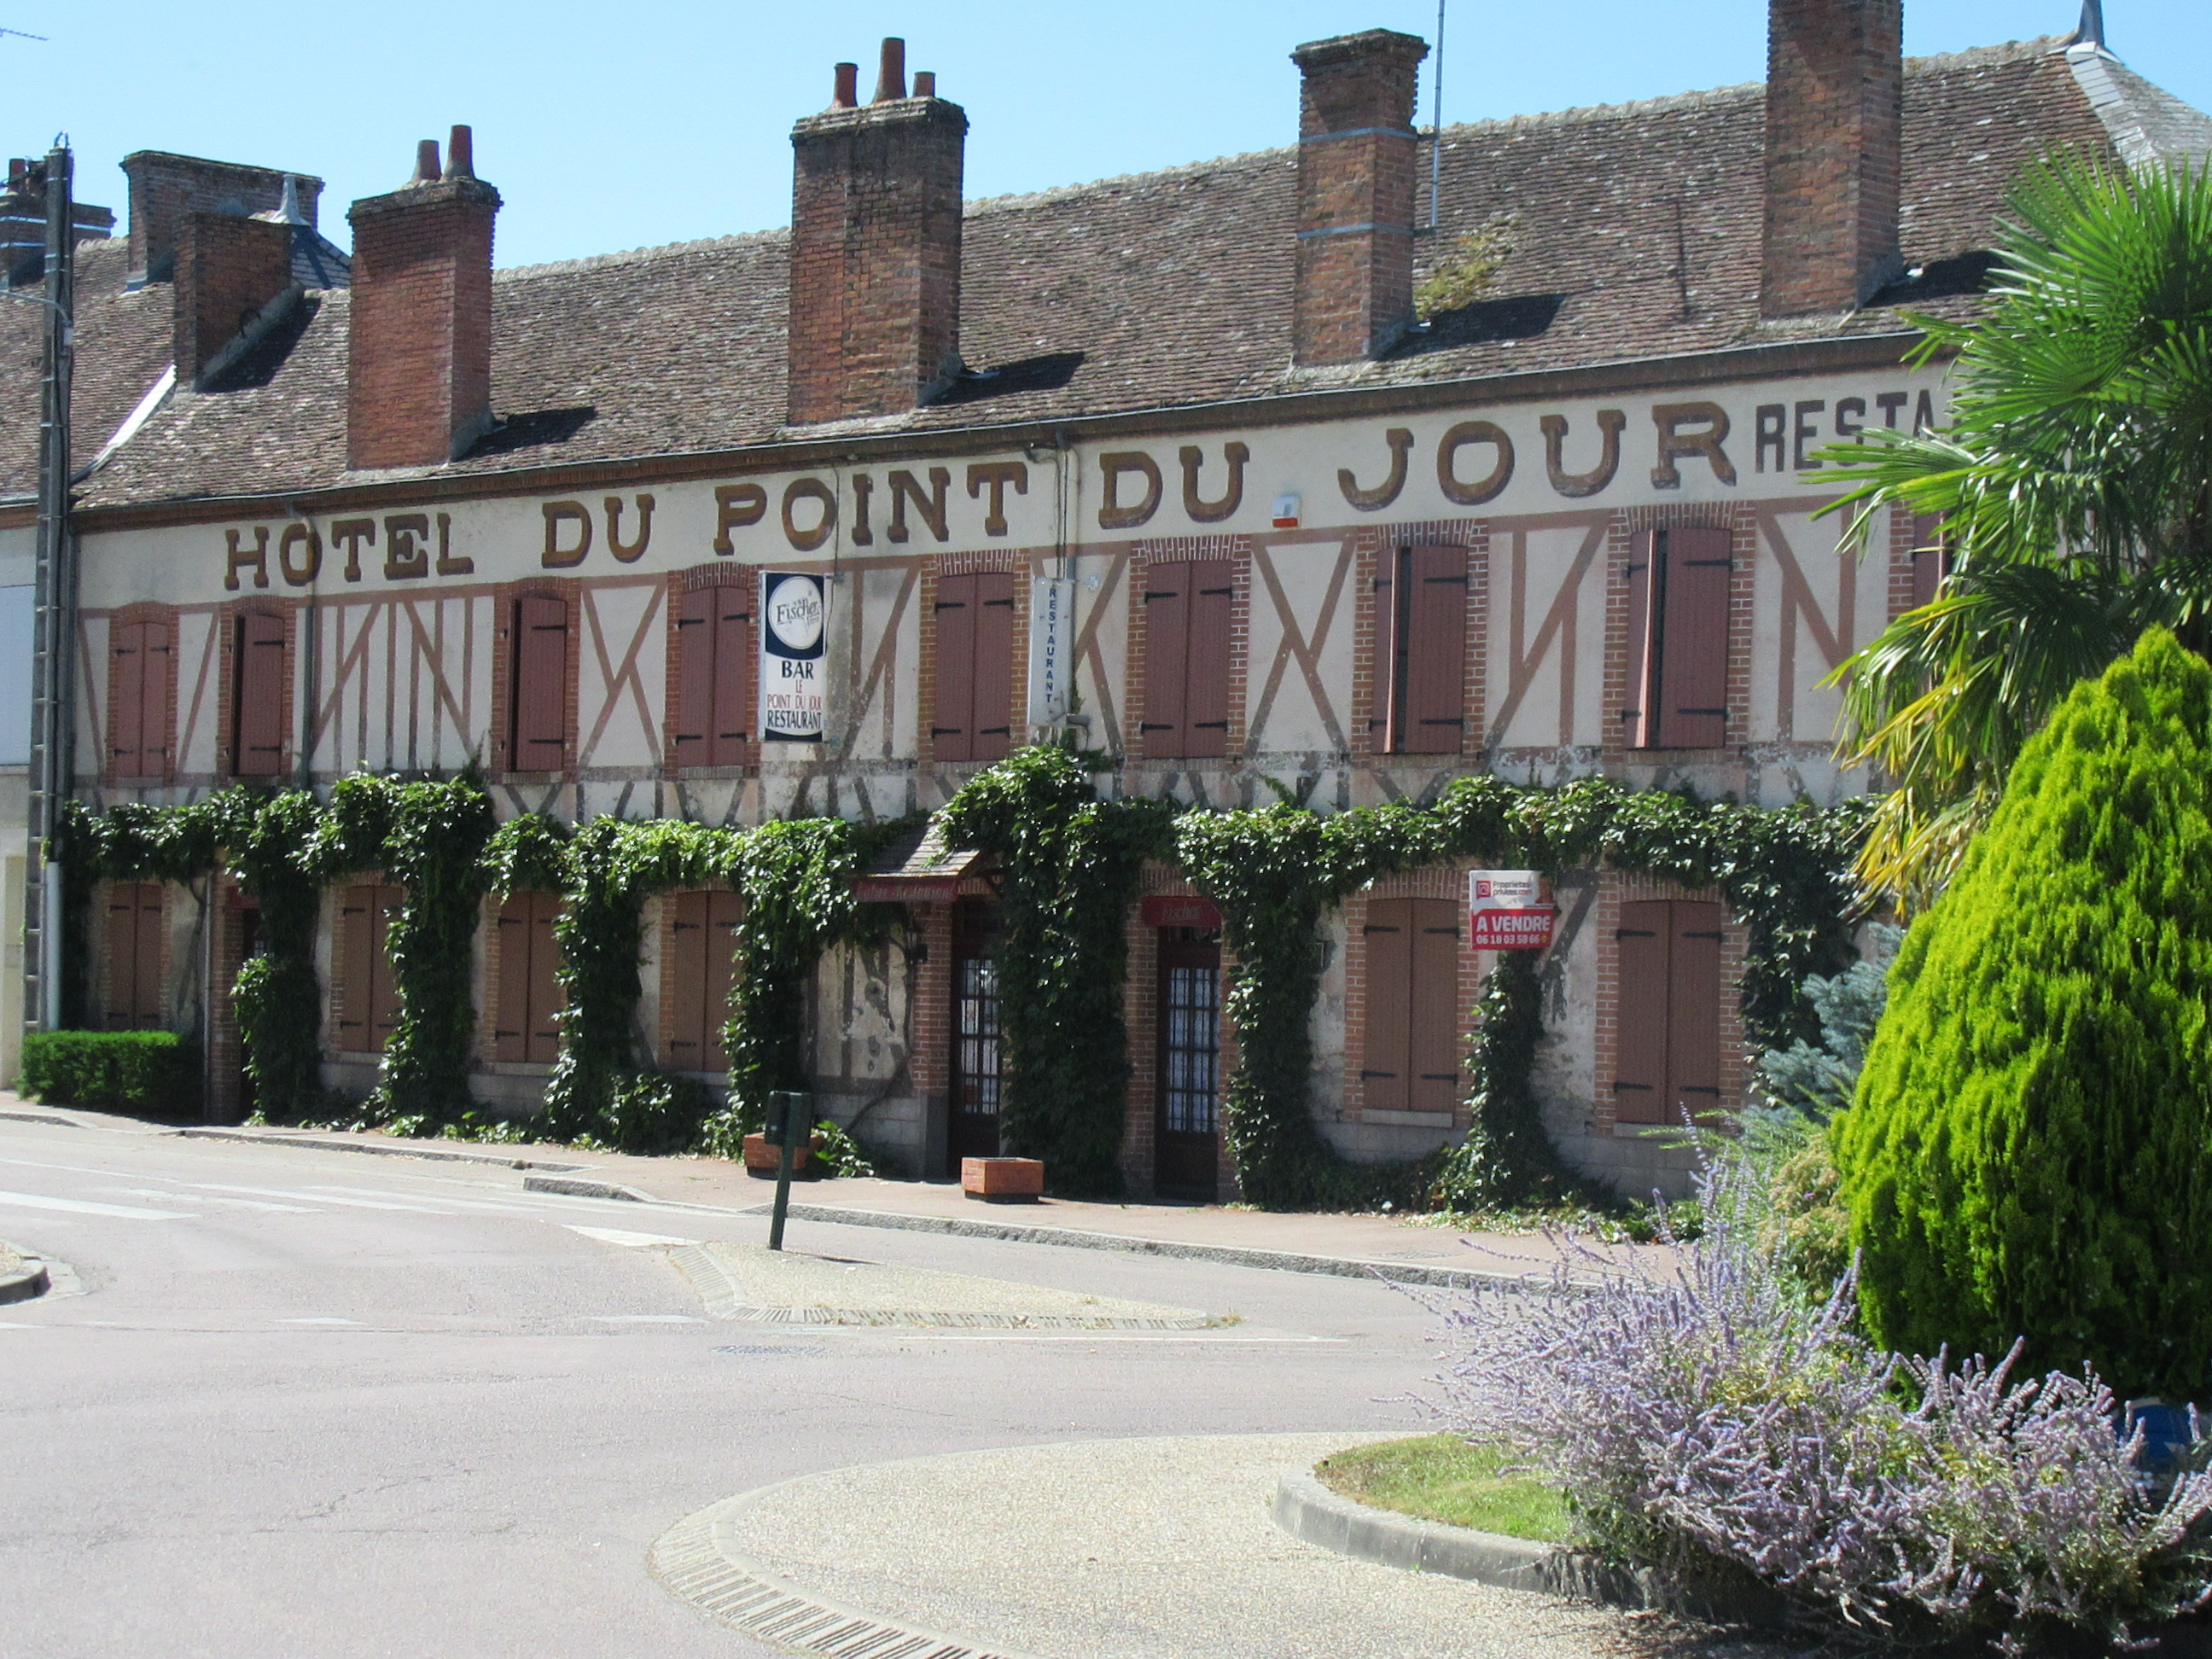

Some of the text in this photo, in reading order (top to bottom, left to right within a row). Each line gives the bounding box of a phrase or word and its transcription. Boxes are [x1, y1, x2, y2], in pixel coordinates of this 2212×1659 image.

[224, 386, 1963, 591] HOTEL DU POINT DU JOUR RESTA
[1045, 587, 1057, 704] RESTAURANT
[782, 660, 814, 679] BAR
[795, 679, 804, 694] LE
[767, 694, 791, 709] POINT
[795, 695, 806, 710] DU
[767, 710, 822, 730] RESTAURANT
[1476, 915, 1551, 932] A VENDRE
[1490, 934, 1502, 945] 18
